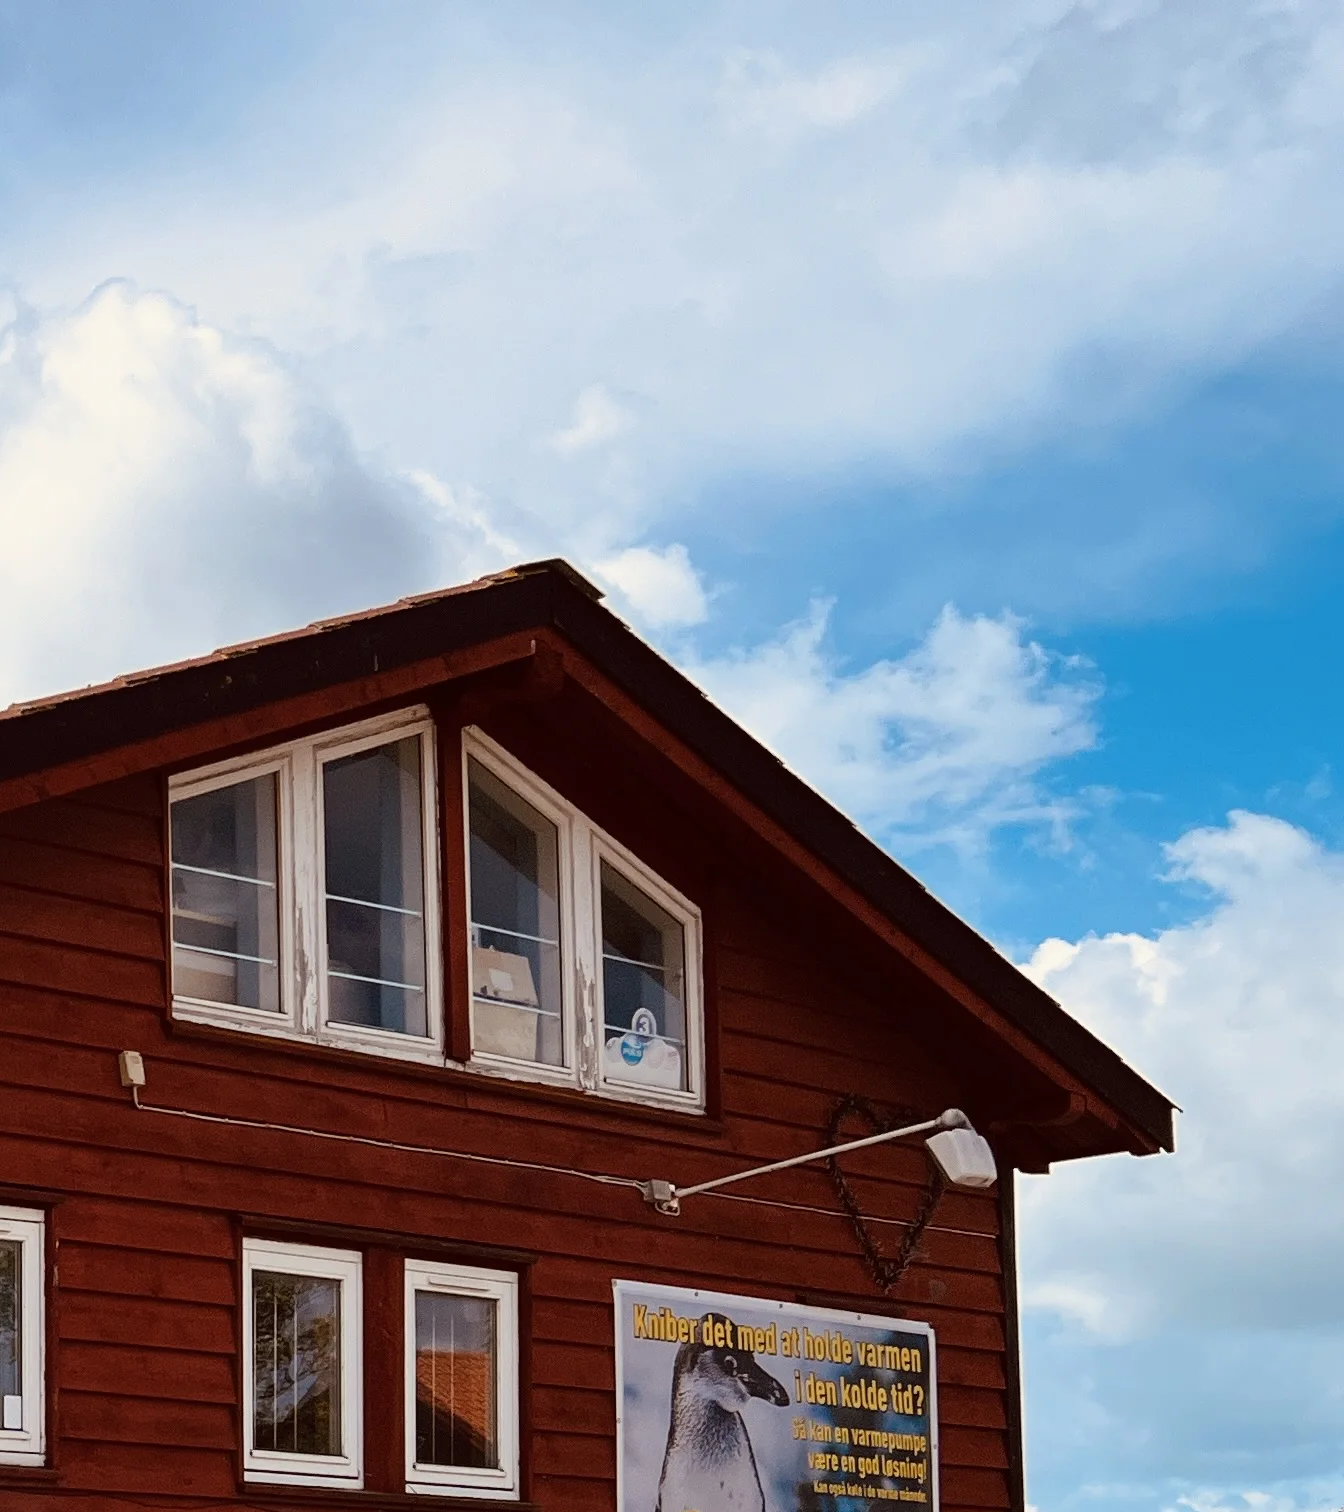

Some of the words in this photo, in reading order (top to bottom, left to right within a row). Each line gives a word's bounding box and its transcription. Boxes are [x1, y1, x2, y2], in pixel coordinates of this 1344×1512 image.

[633, 1303, 698, 1344] Kniber
[703, 1314, 733, 1348] det
[738, 1322, 777, 1355] med
[781, 1327, 800, 1358] at
[803, 1327, 852, 1364] holde
[856, 1341, 922, 1373] varmen
[794, 1369, 801, 1403] i
[806, 1371, 837, 1407] den
[840, 1376, 888, 1412] kolde
[891, 1382, 924, 1415] tid?
[809, 1423, 832, 1442] kan
[834, 1427, 849, 1444] en
[851, 1428, 926, 1456] varmepumpe
[808, 1451, 838, 1471] være
[841, 1455, 856, 1473] en
[858, 1454, 879, 1479] god
[881, 1455, 927, 1484] løsning!
